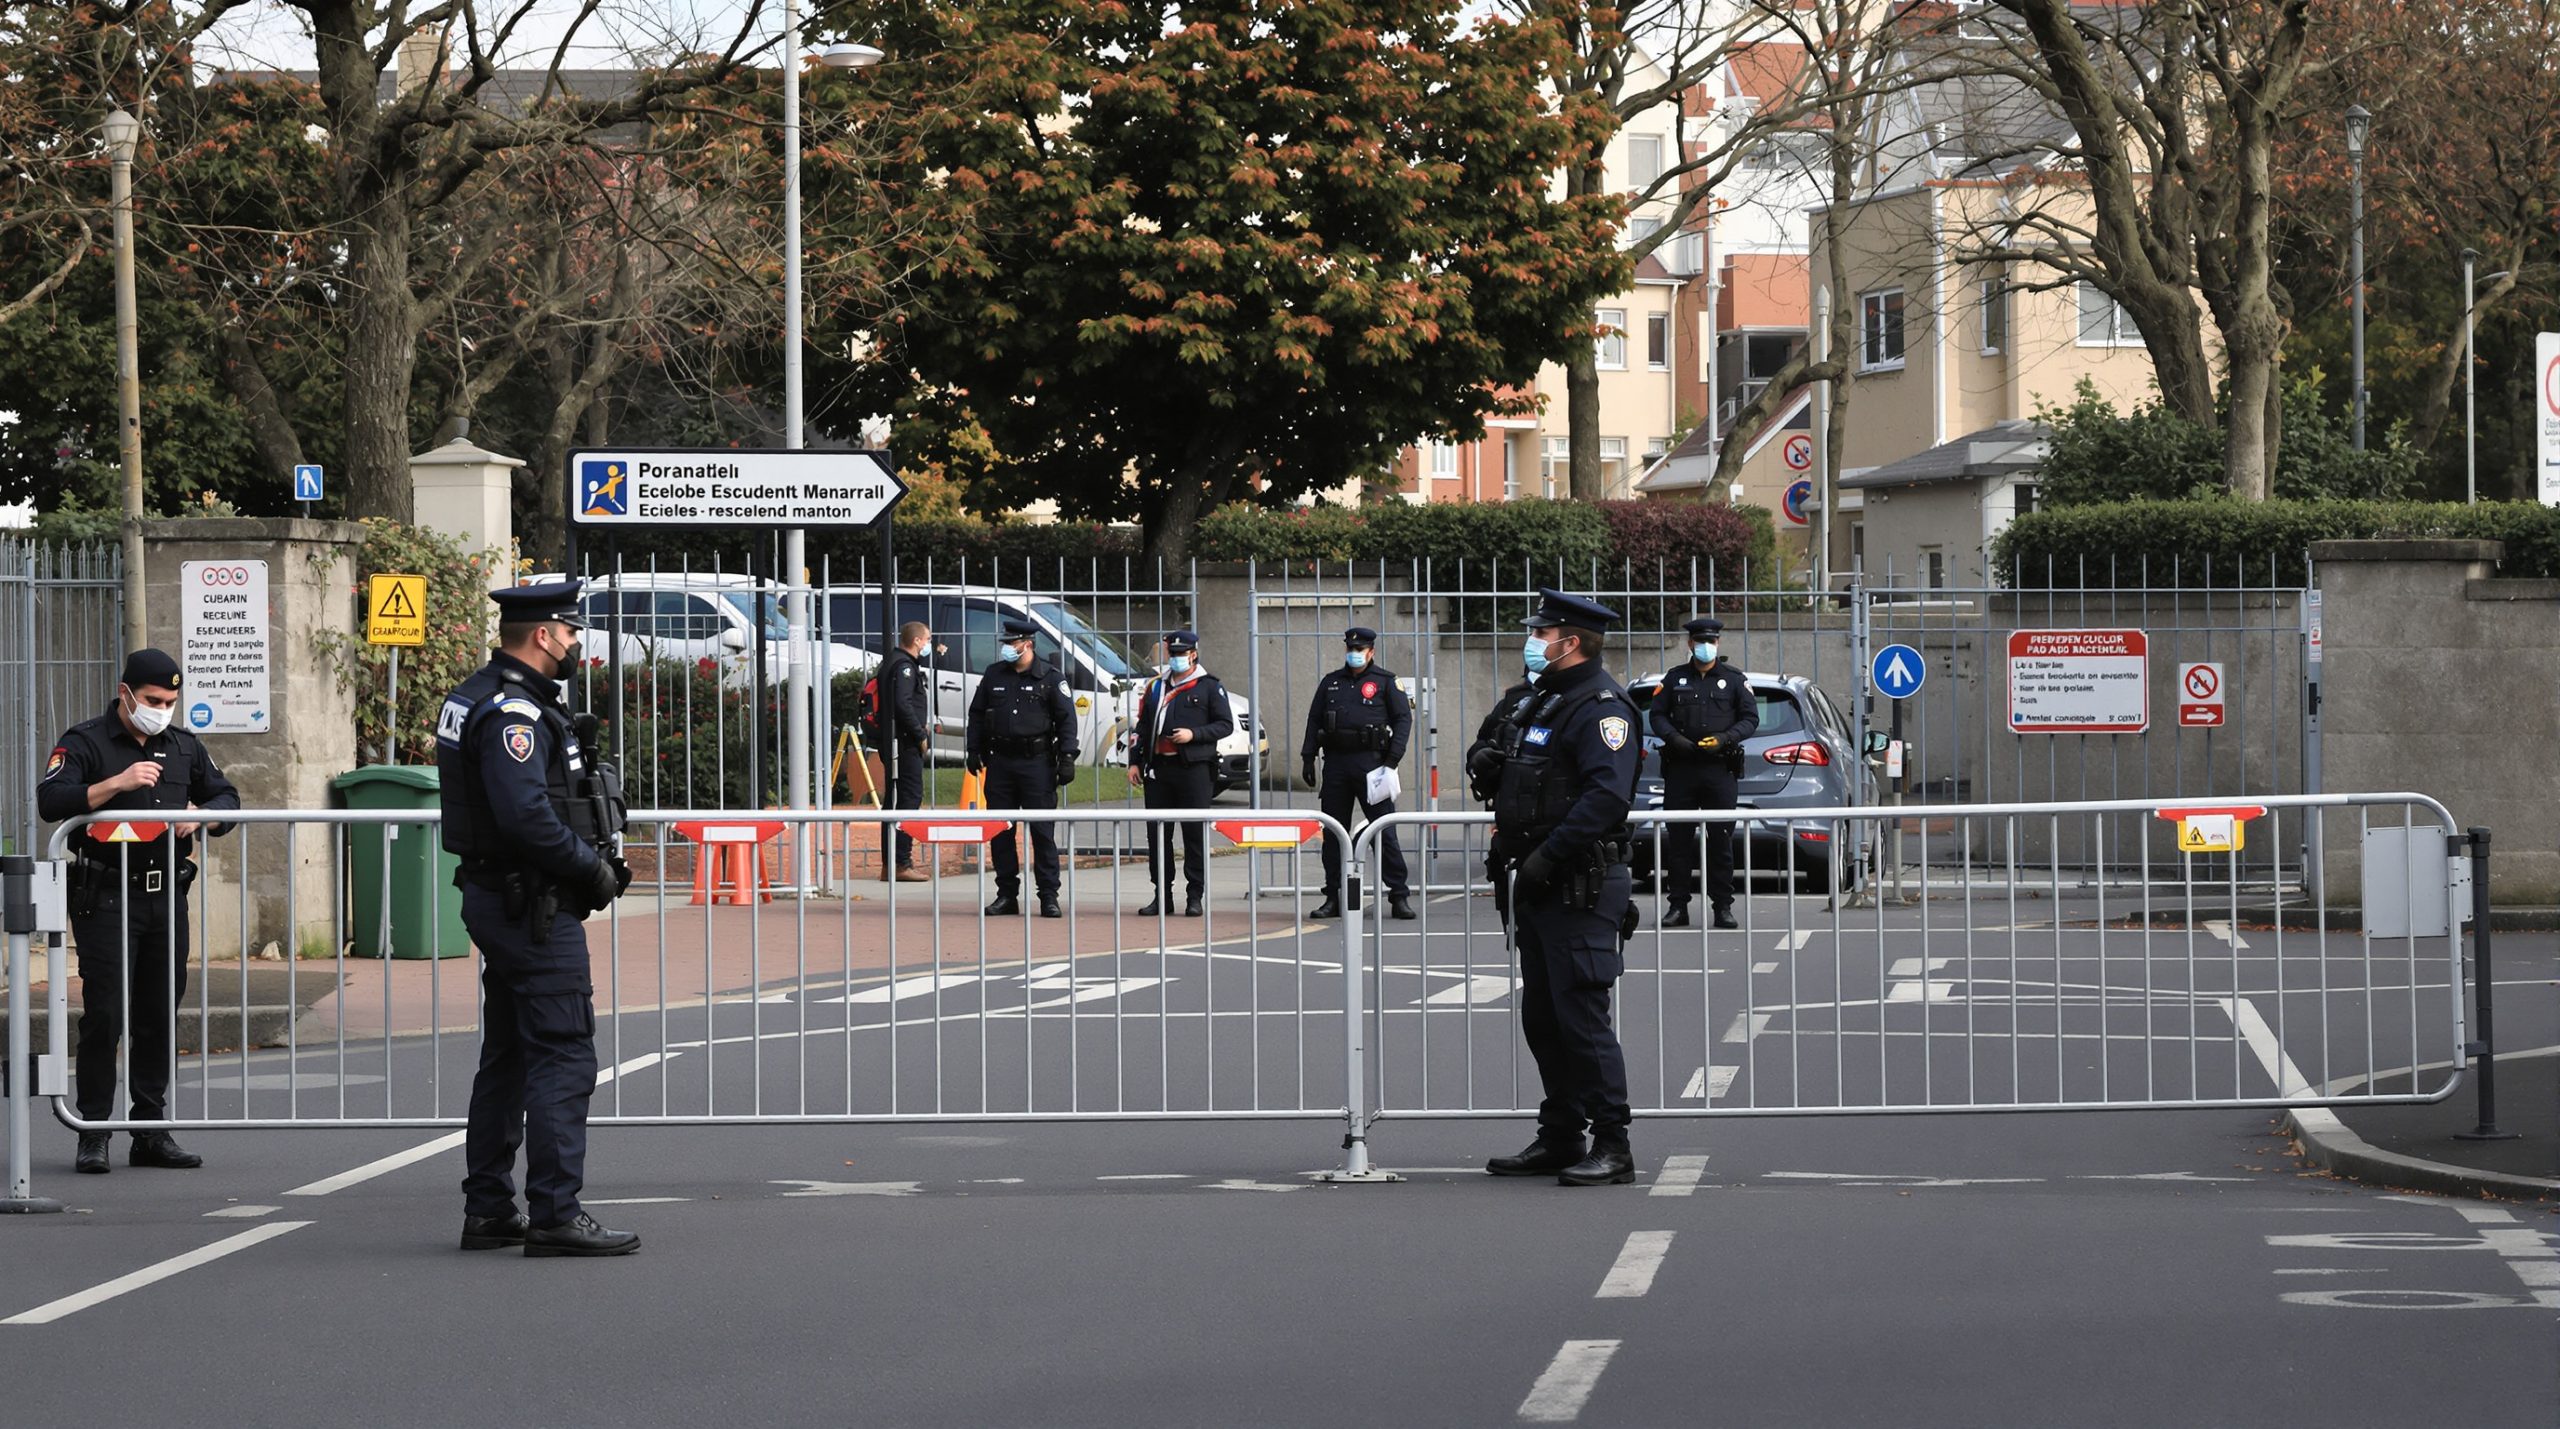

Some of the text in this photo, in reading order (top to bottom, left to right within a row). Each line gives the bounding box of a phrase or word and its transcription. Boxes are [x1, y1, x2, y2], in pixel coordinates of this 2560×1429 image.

[639, 484, 706, 498] Ecelobe
[639, 504, 698, 517] Ecieles
[708, 504, 787, 517] rescelend
[792, 505, 851, 517] manton
